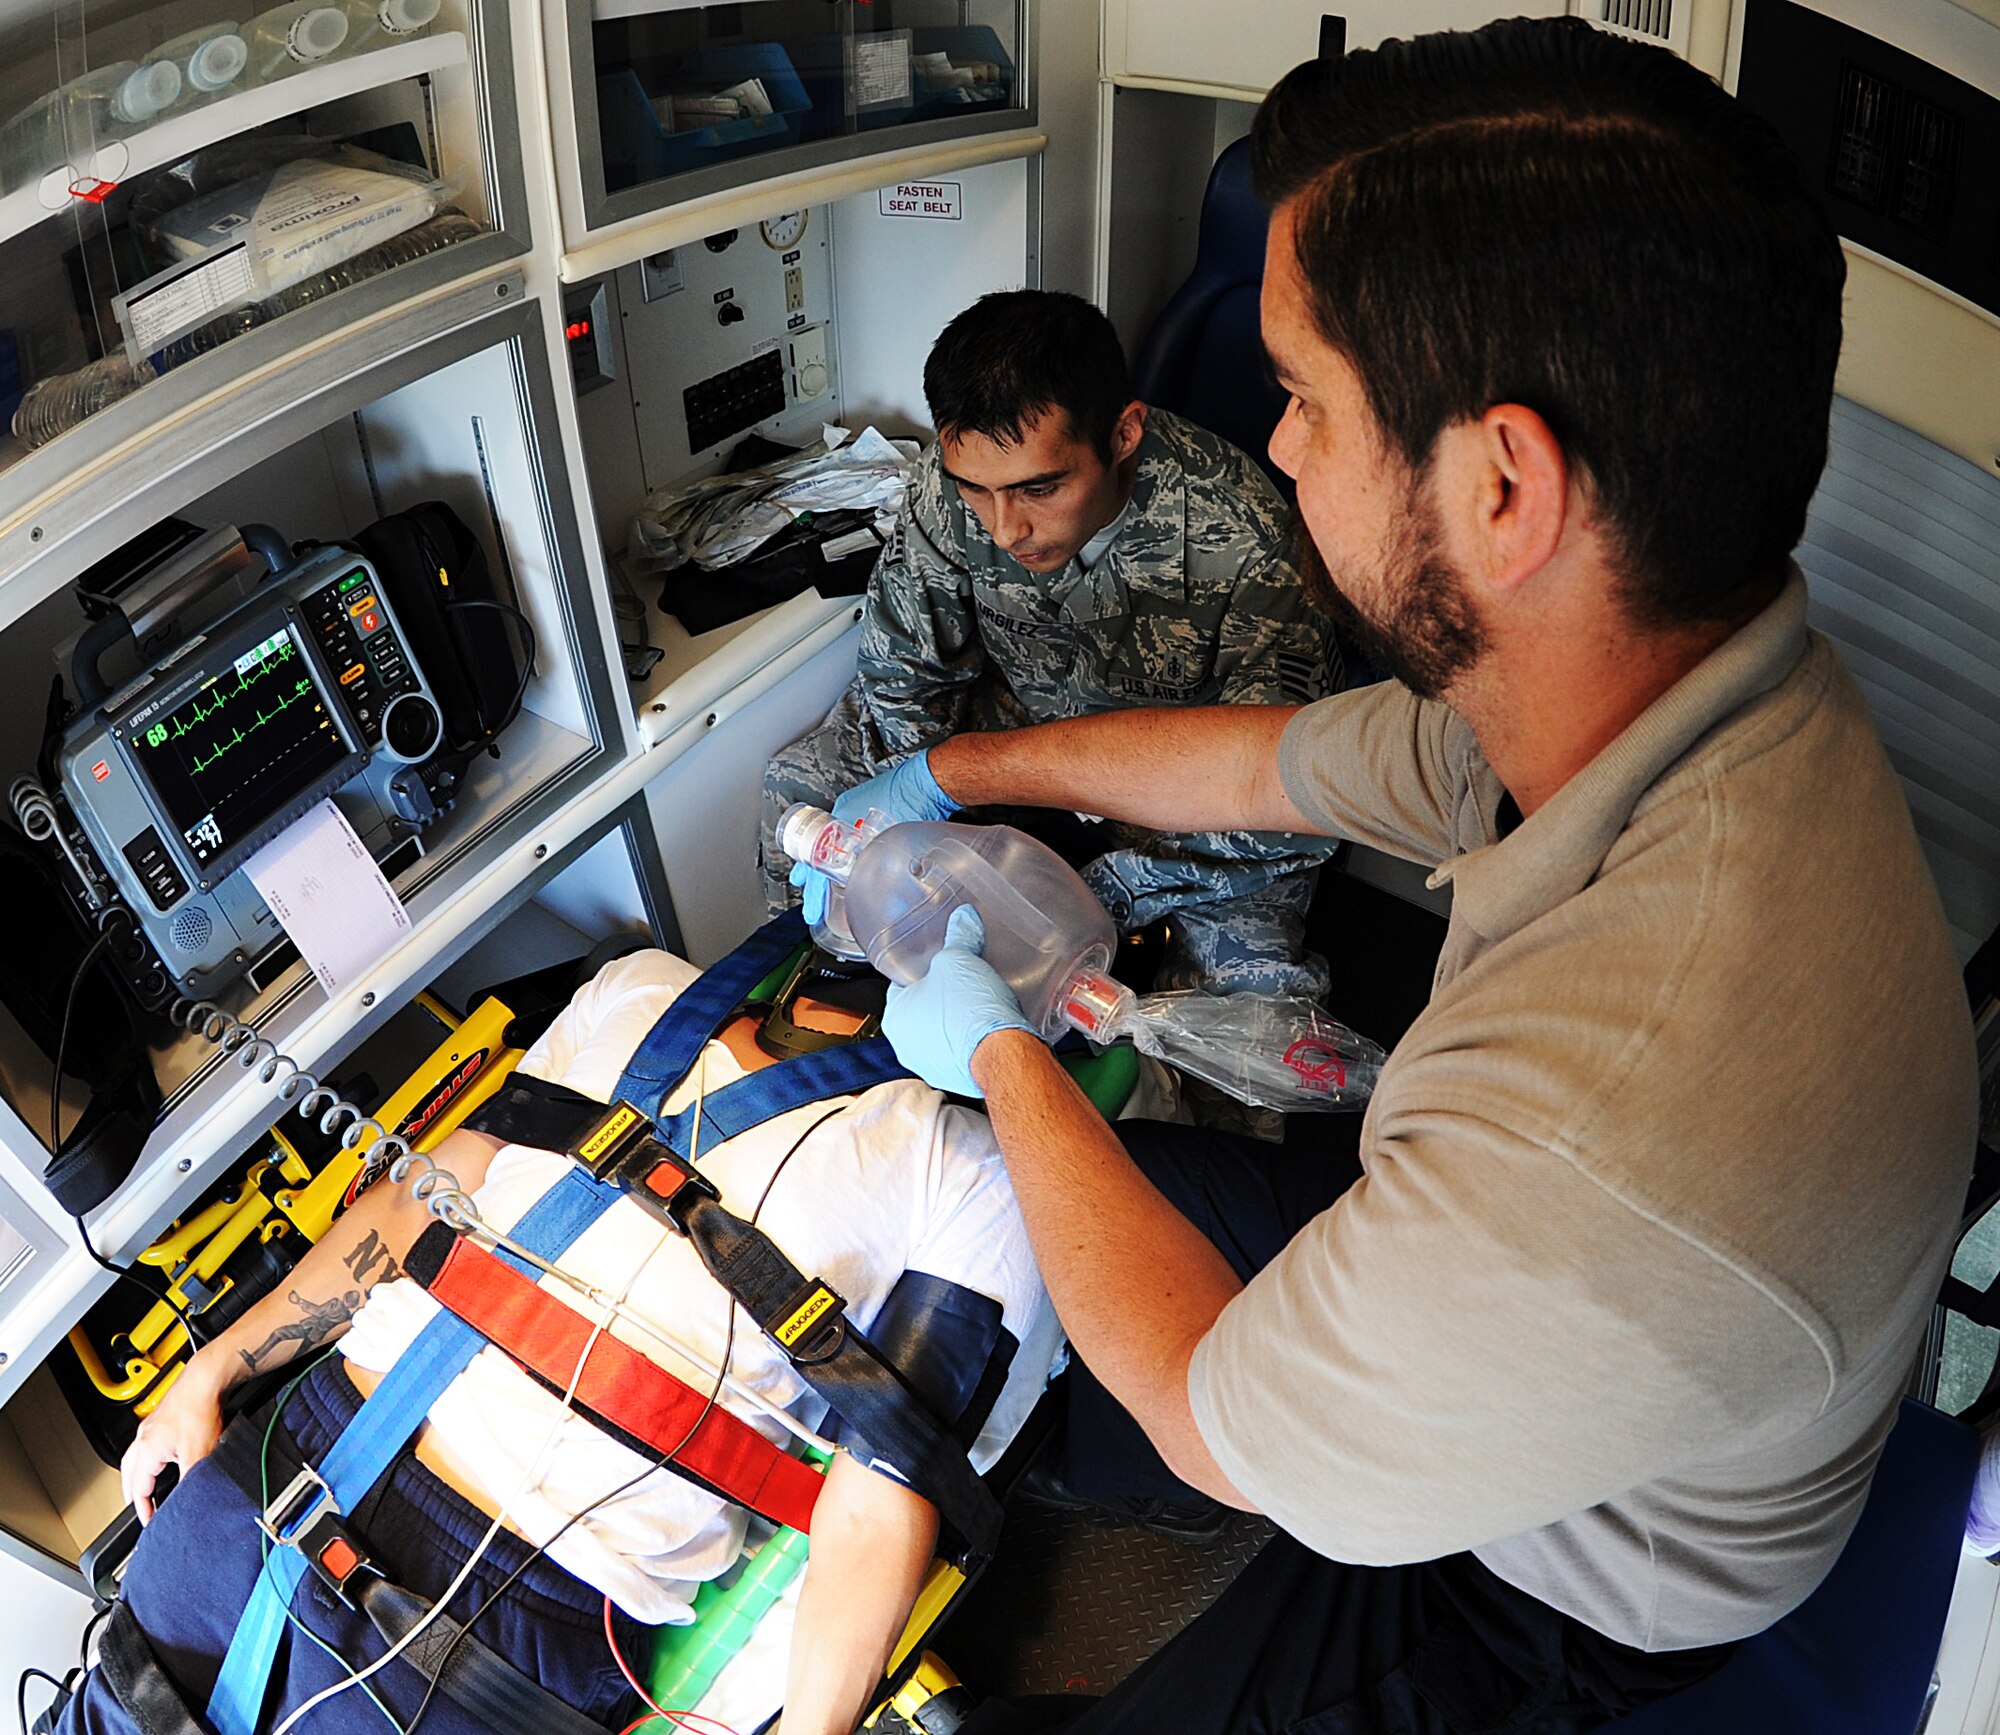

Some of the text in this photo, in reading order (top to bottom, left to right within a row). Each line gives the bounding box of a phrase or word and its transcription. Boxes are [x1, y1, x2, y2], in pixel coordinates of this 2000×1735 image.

[897, 186, 942, 197] FASTEN
[271, 195, 361, 232] Proxima
[889, 200, 952, 213] SEAT BELT
[978, 601, 1039, 639] URGILEZ
[1121, 678, 1150, 697] U.S.
[1153, 684, 1180, 700] AIR
[146, 723, 168, 747] 68
[197, 819, 219, 841] 121
[591, 1116, 626, 1151] RUGGED
[787, 1299, 823, 1334] RUGGED
